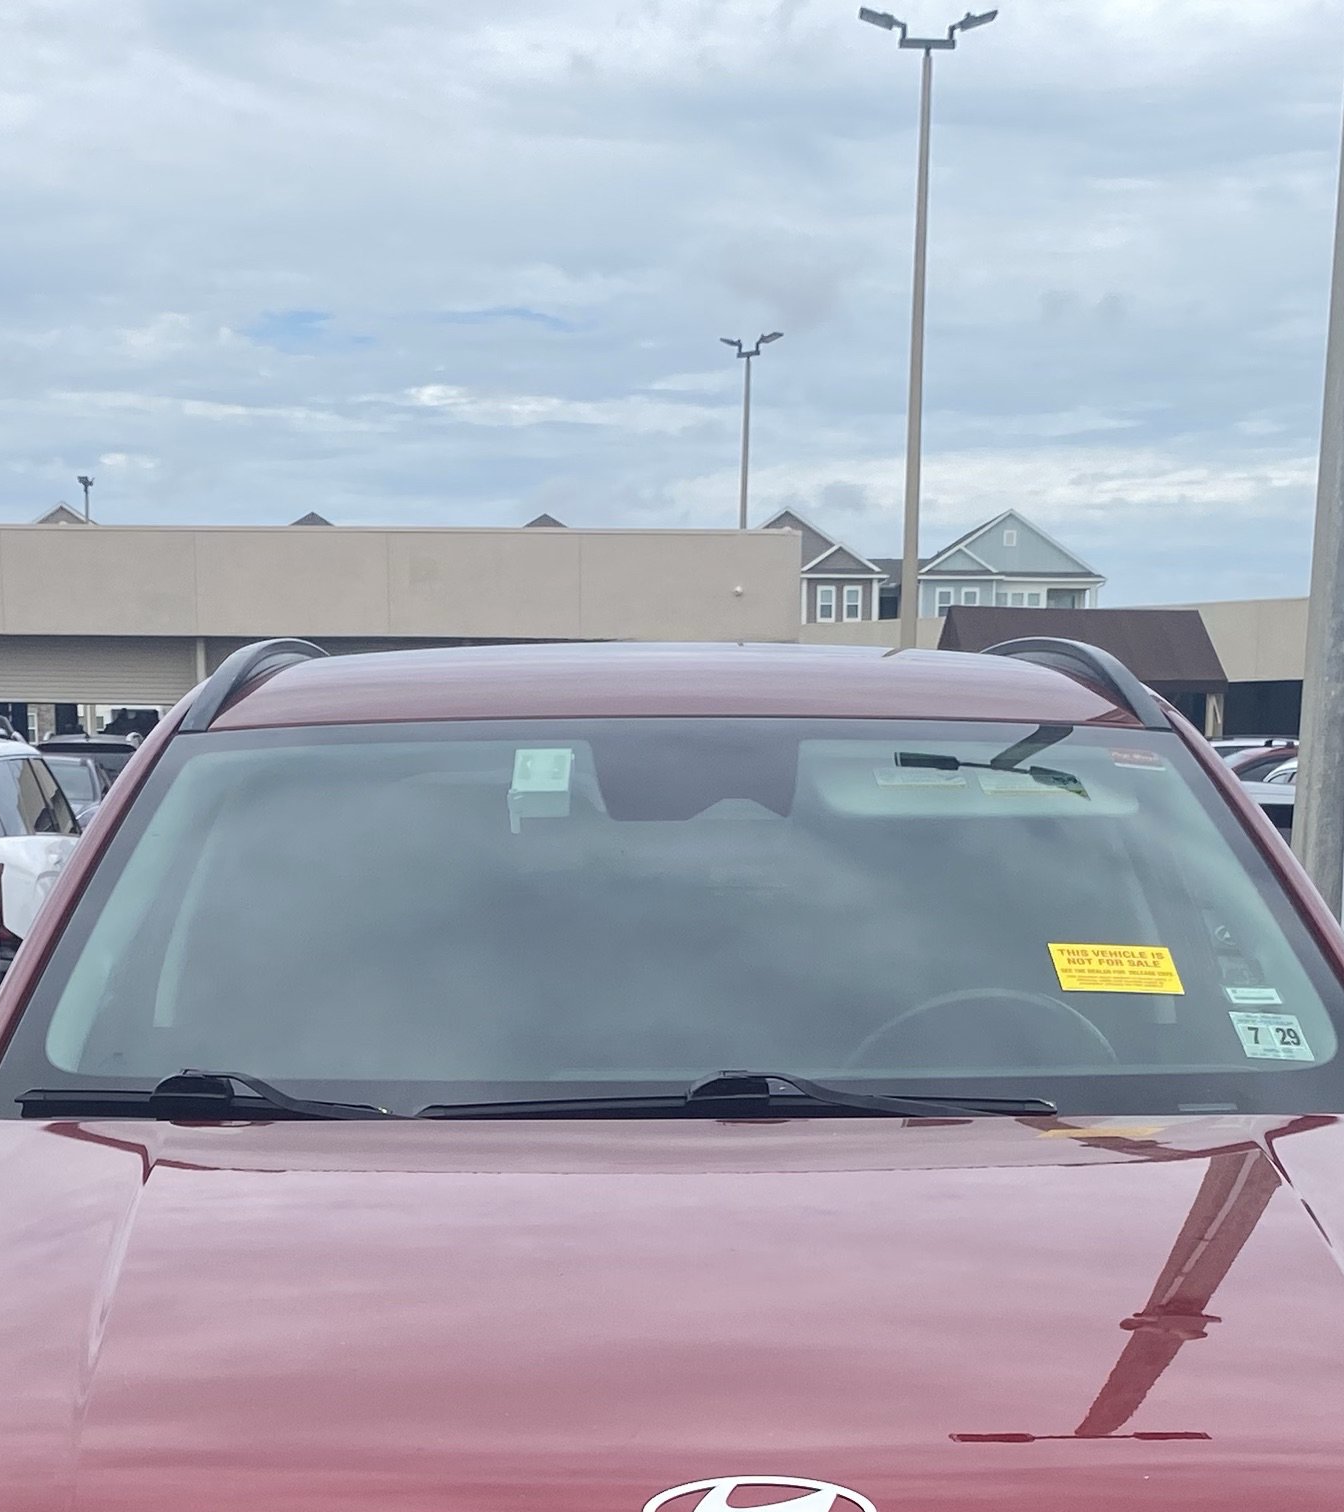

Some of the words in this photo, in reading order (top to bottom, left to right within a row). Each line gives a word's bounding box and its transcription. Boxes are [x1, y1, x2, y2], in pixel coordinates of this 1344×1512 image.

[1057, 948, 1089, 957] THIS
[1091, 949, 1148, 959] VEHICLE
[1151, 951, 1165, 960] IS
[1067, 957, 1093, 966] NOT
[1098, 958, 1124, 967] FOR
[1128, 959, 1161, 968] SALE
[1247, 1026, 1260, 1045] 7
[1275, 1027, 1301, 1046] 29
